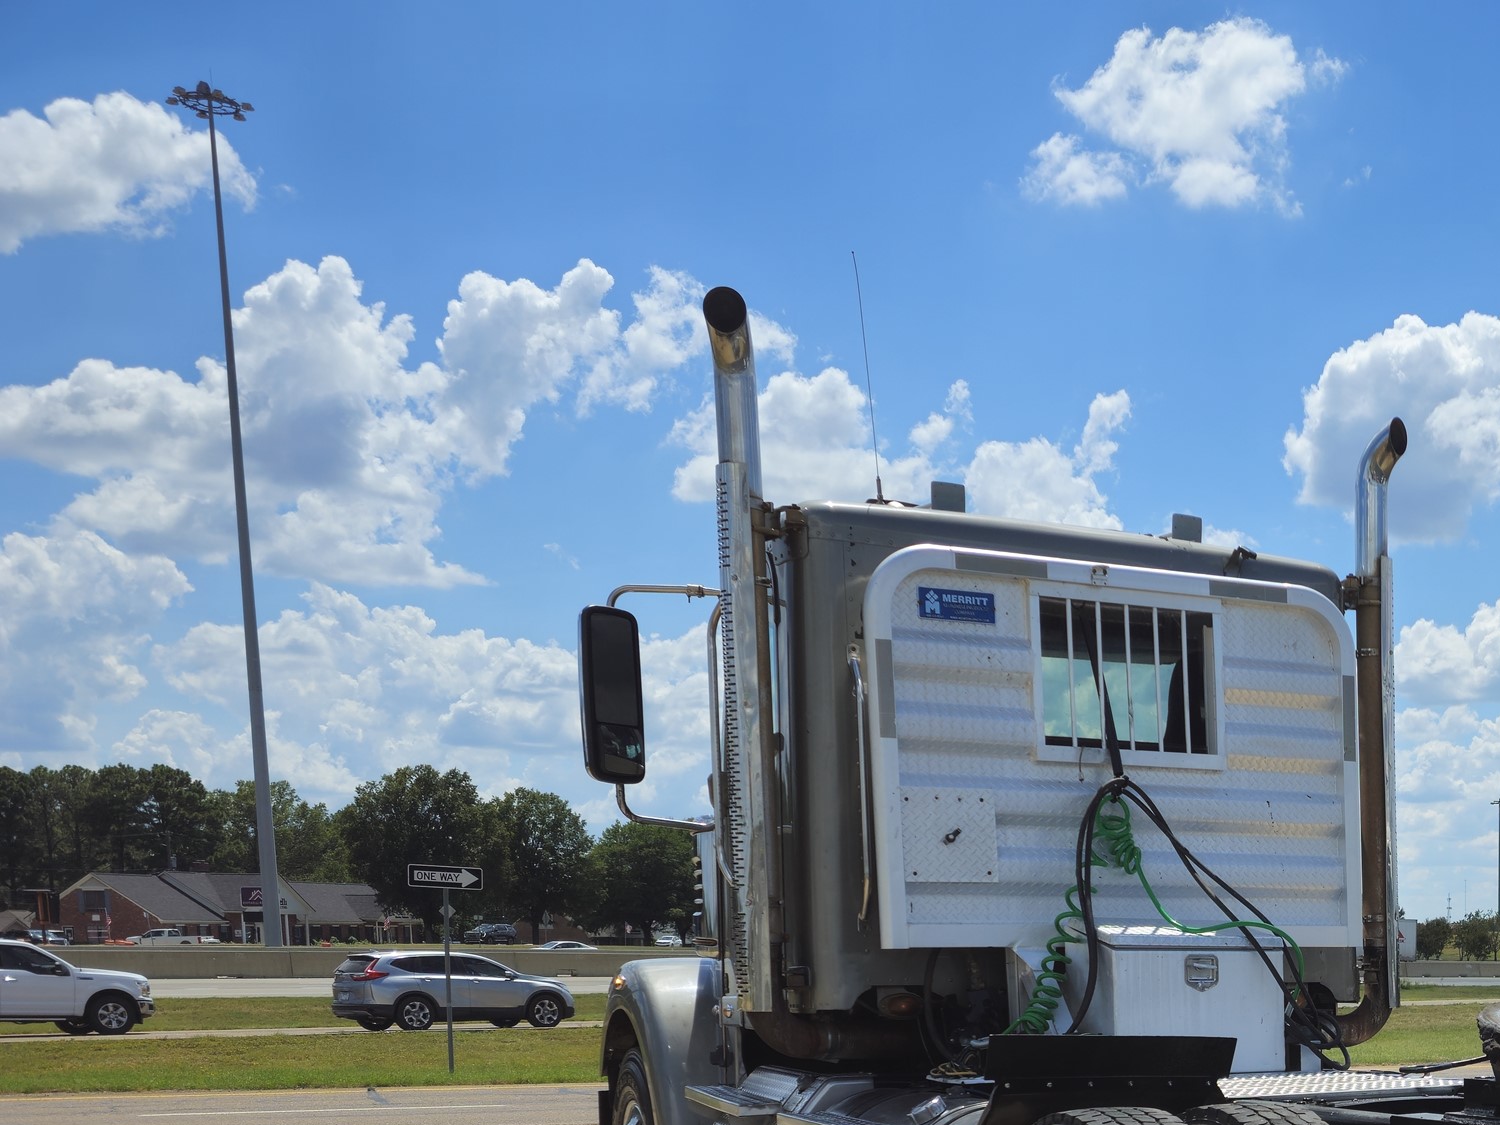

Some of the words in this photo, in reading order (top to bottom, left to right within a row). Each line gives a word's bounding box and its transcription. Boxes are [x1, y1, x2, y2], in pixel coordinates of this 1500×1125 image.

[942, 594, 989, 606] MERRITT
[416, 871, 437, 881] ONE
[439, 872, 460, 882] WAY
